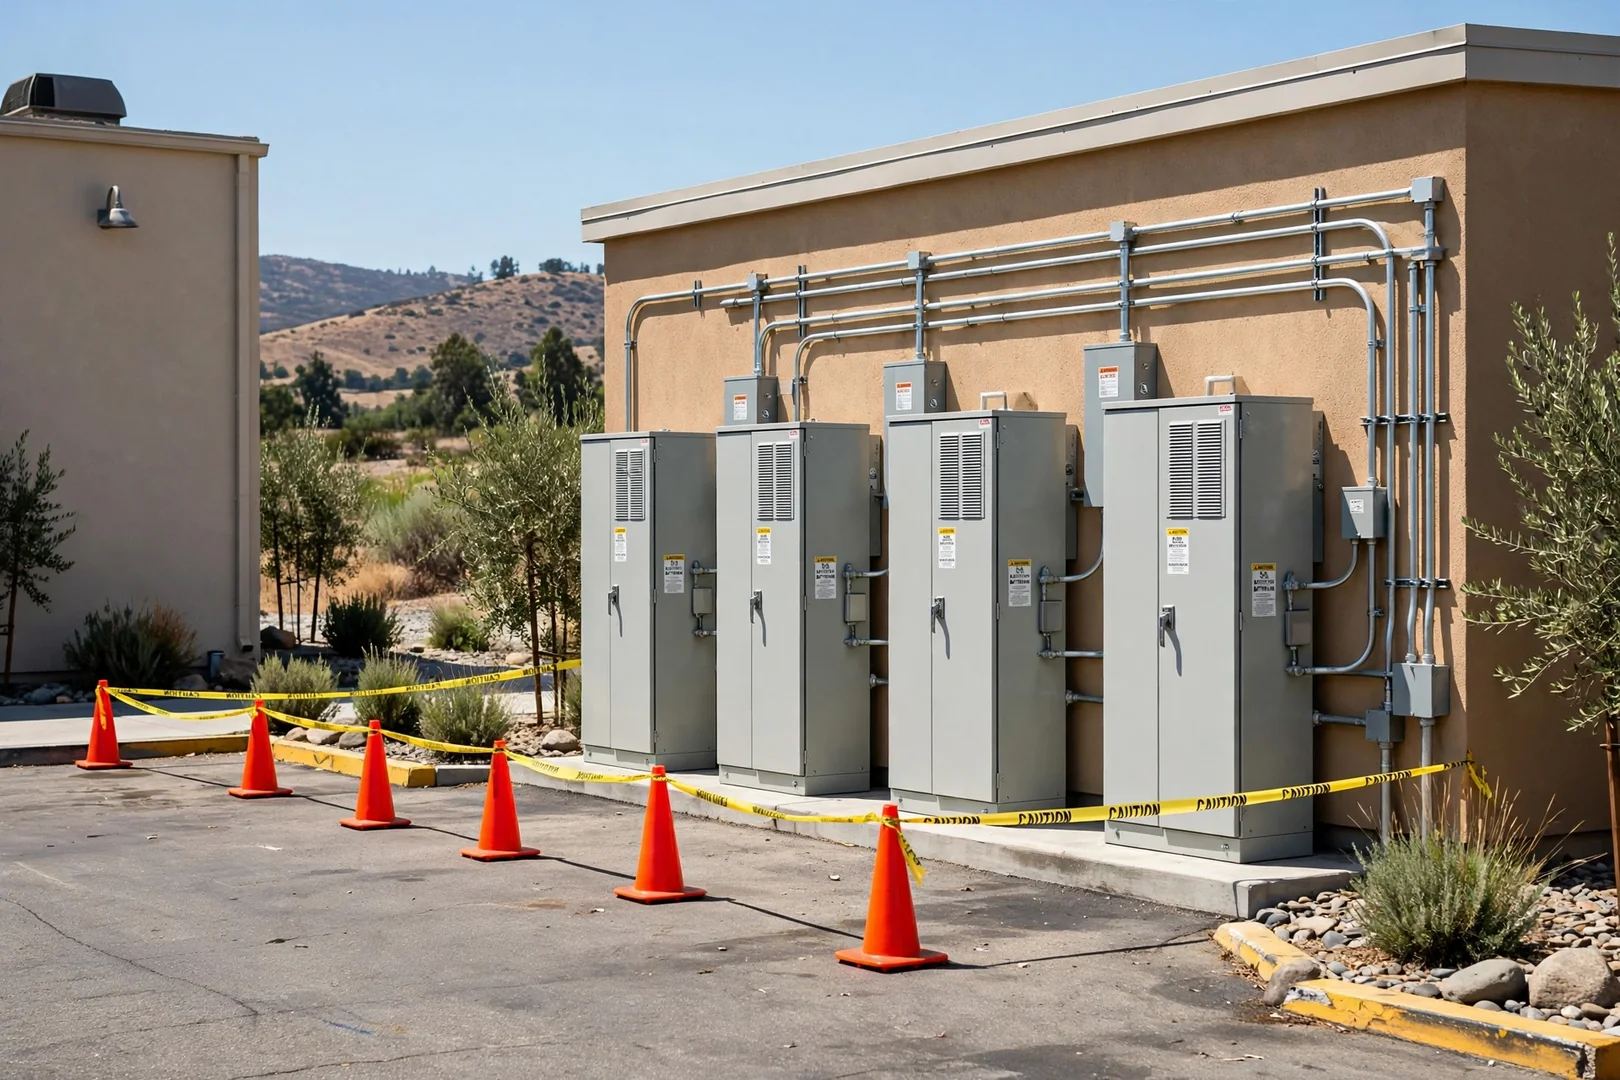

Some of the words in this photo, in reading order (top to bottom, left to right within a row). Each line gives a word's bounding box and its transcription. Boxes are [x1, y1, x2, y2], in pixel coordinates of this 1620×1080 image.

[1365, 771, 1412, 786] CAUTION
[1282, 784, 1331, 800] CAUTION
[1196, 795, 1247, 811] CAUTION
[1018, 811, 1072, 825] CAUTION
[1109, 804, 1160, 819] CAUTION
